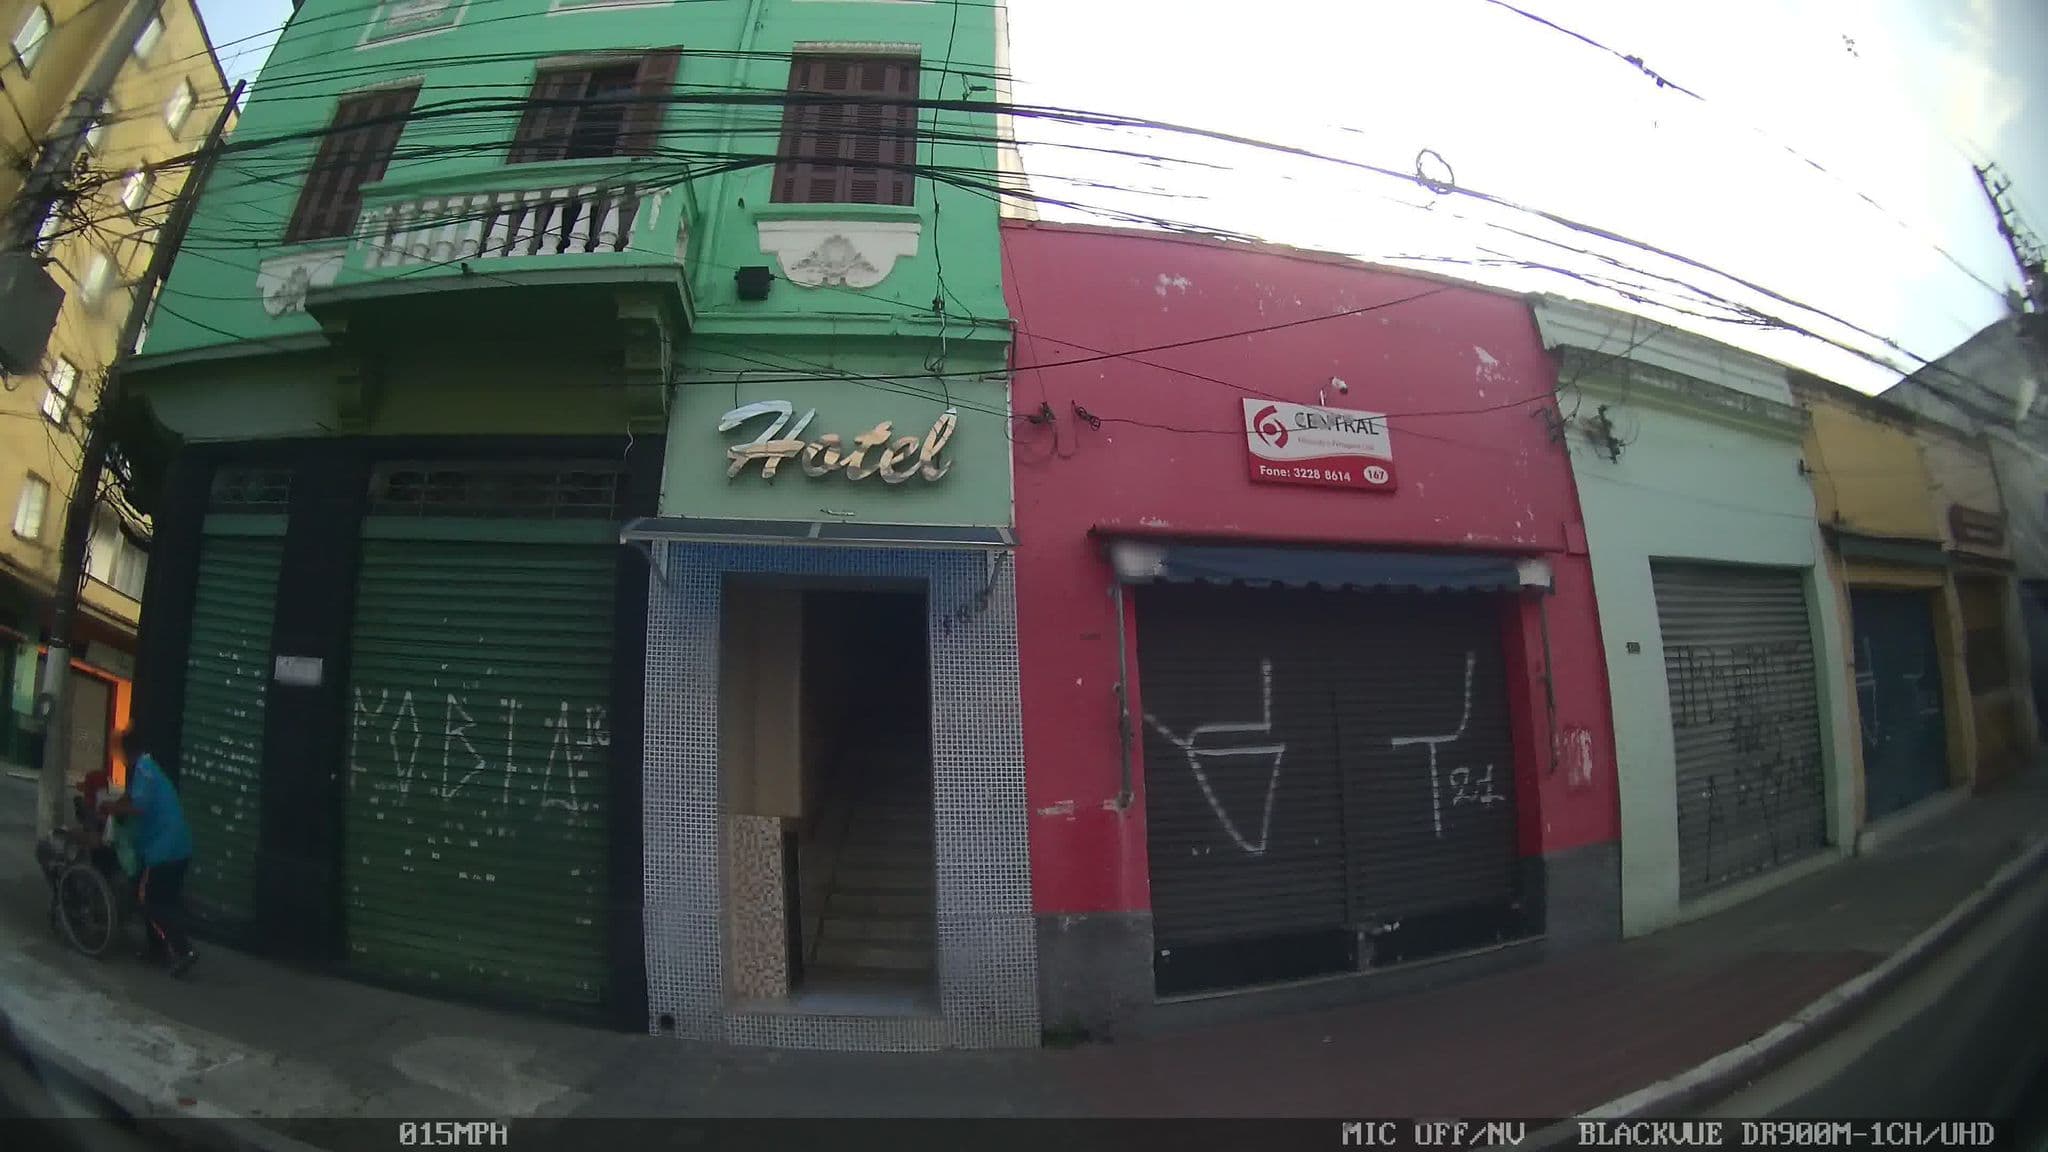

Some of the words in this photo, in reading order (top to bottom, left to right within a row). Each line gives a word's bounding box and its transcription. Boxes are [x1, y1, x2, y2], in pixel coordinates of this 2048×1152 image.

[1295, 412, 1379, 435] CENTRAL
[718, 400, 957, 483] Hotel
[1260, 465, 1290, 477] Fone:
[1293, 467, 1320, 480] 3228
[1324, 470, 1351, 482] 8614
[1368, 469, 1384, 480] 167
